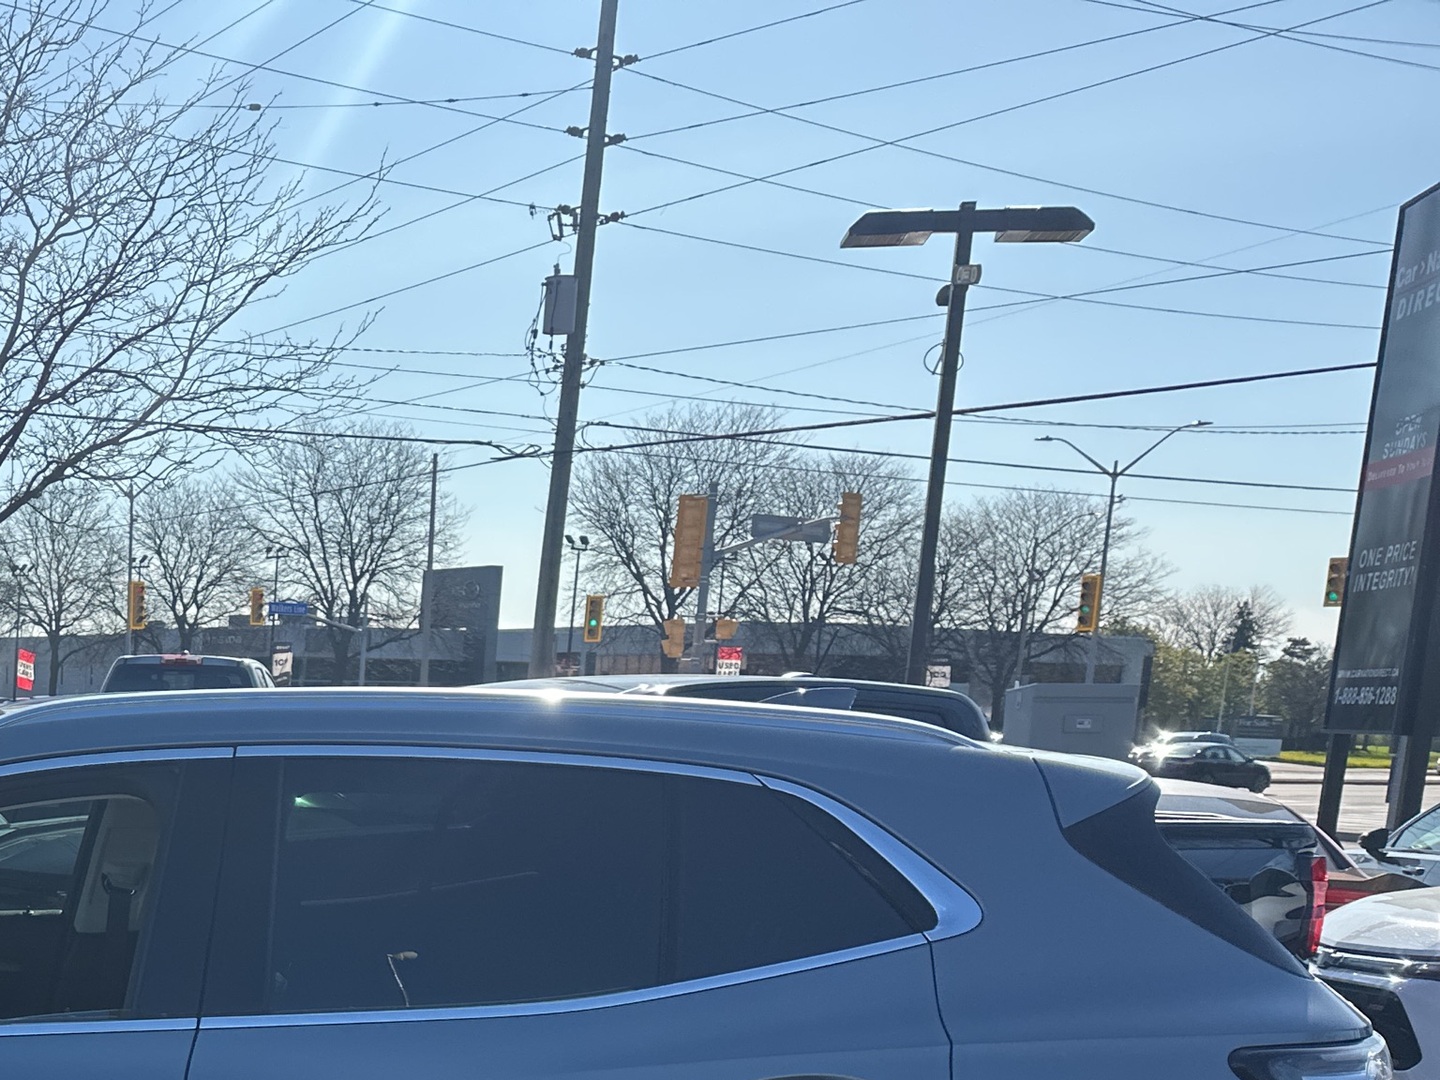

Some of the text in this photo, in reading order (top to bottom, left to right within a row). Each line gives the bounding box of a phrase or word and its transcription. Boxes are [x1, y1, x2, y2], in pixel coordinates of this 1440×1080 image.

[1397, 265, 1418, 288] Car
[1382, 431, 1428, 459] SUNDAYS
[1359, 540, 1417, 568] ONE PRICE
[1353, 566, 1415, 592] INTEGRITY!
